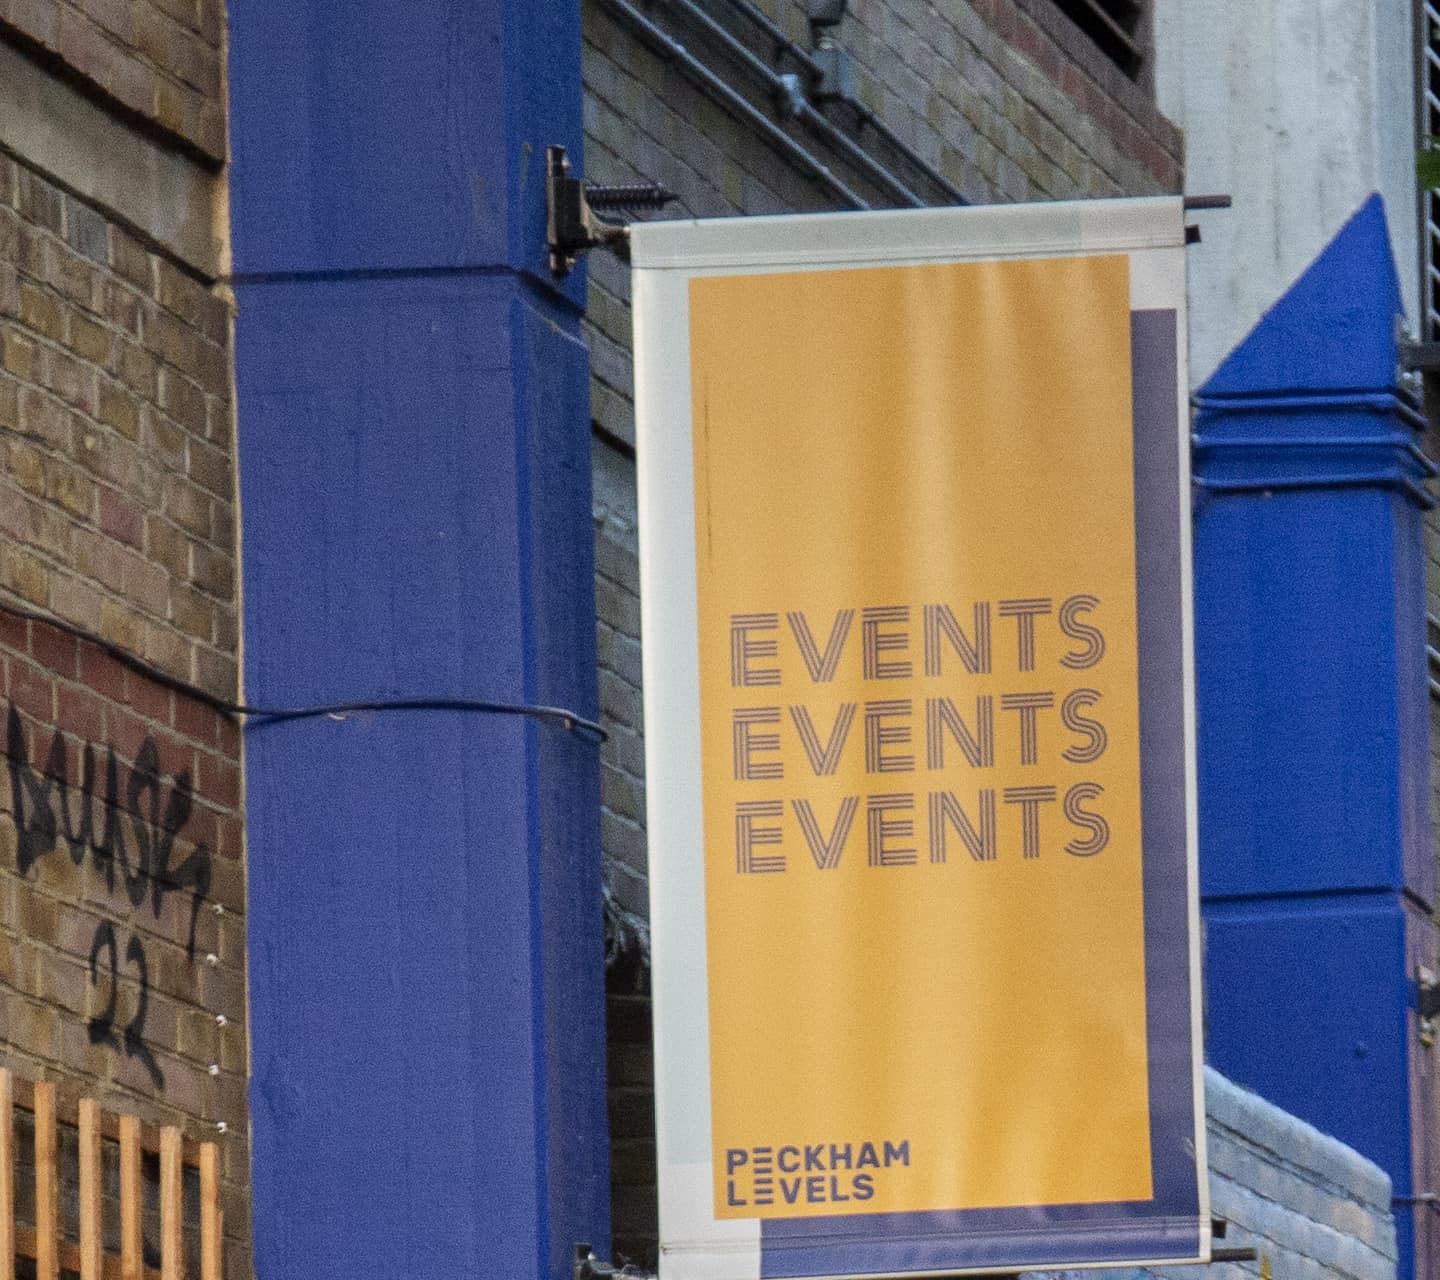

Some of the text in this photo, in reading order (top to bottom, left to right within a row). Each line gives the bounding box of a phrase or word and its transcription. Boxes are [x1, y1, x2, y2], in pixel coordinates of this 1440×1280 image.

[729, 593, 1107, 689] EVENTS
[731, 687, 1109, 783] EVENTS
[734, 781, 1111, 876] EVENTS
[726, 1139, 911, 1178] PECKHAM
[726, 1173, 876, 1207] LEVELS
